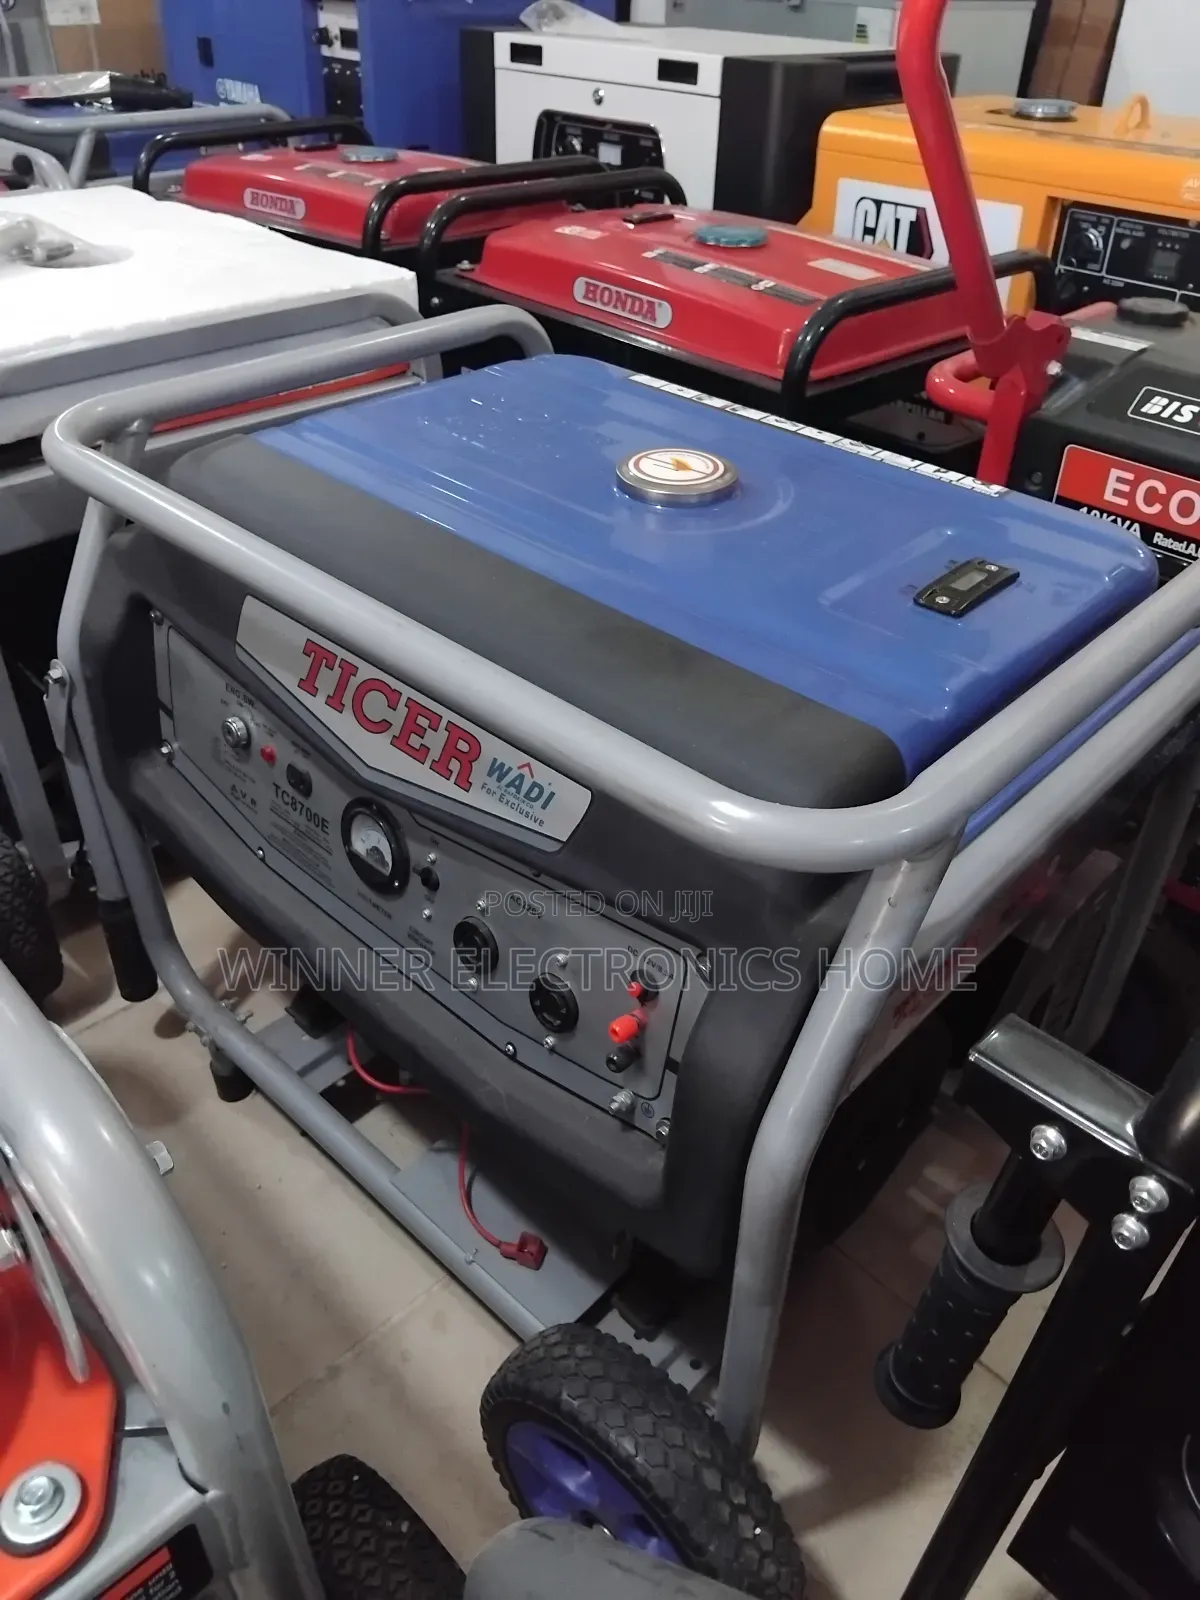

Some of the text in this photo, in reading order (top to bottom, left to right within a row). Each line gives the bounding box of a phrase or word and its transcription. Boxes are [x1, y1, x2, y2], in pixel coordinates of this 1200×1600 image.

[250, 190, 296, 215] HONDA
[852, 197, 917, 254] CAT
[582, 281, 657, 322] HONDA
[1140, 395, 1200, 424] BIS
[297, 638, 482, 793] TICER
[272, 782, 330, 836] TC8700E
[480, 782, 545, 827] For Exclusive
